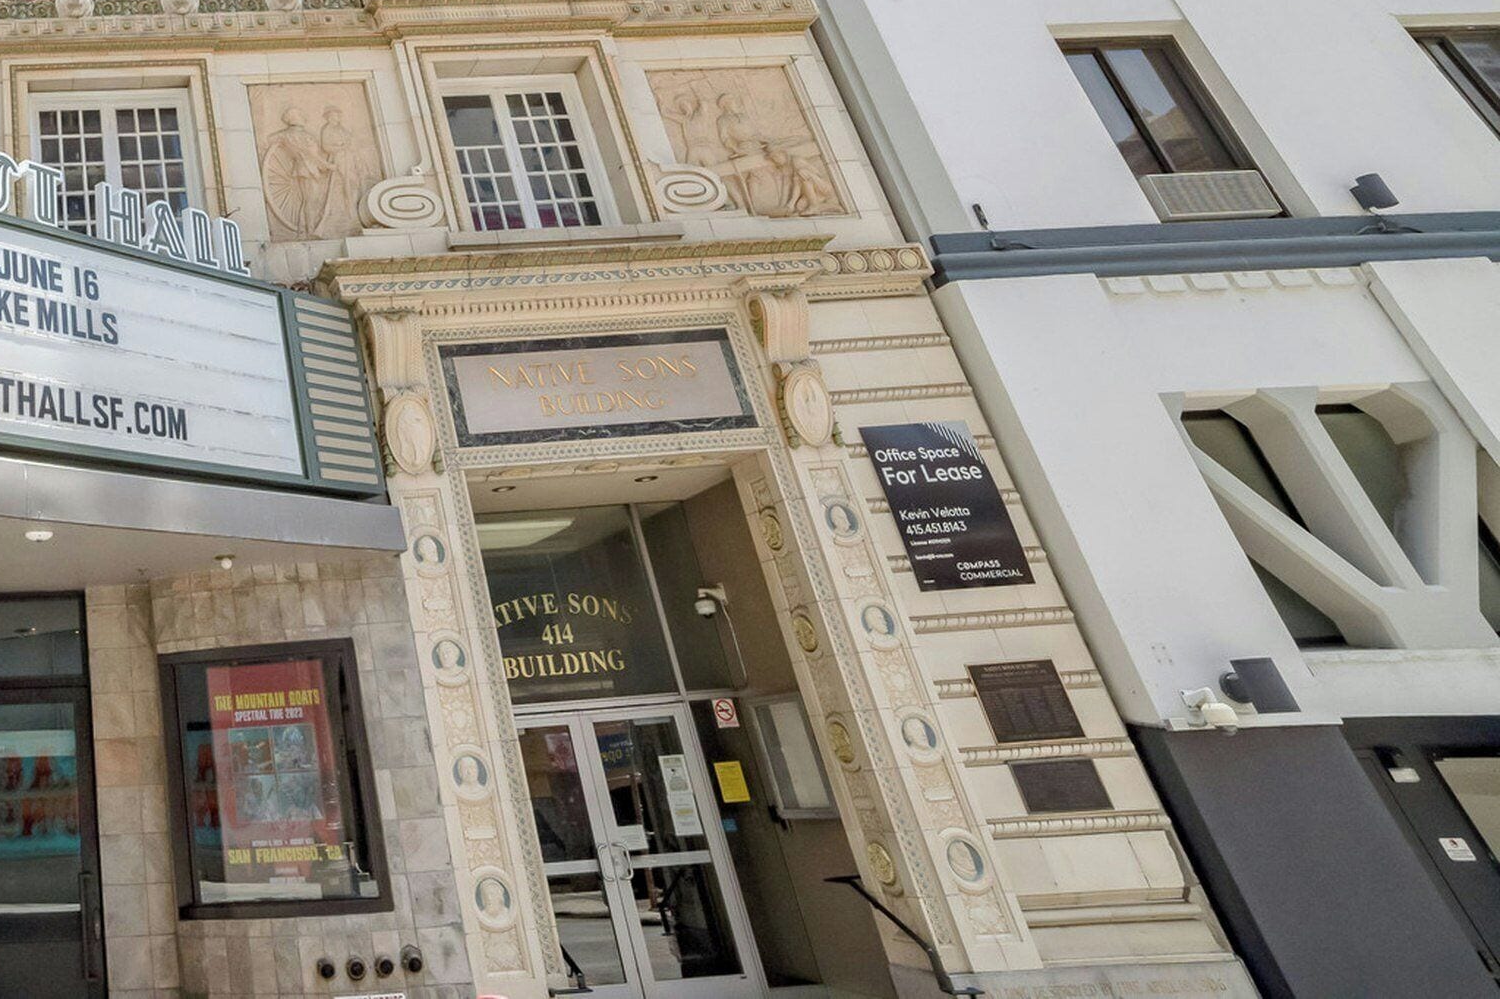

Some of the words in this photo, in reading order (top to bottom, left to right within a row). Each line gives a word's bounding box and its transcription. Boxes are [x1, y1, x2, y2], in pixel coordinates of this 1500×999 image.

[94, 181, 252, 277] HALL
[74, 266, 100, 301] 16
[36, 296, 119, 345] MILLS
[486, 359, 597, 391] NATIVE
[615, 354, 699, 384] SONS
[538, 389, 667, 418] BUILDING
[875, 447, 917, 463] Office
[917, 446, 961, 463] Space
[881, 465, 918, 487] For
[919, 463, 983, 484] Lease
[899, 508, 931, 521] Kevin
[929, 505, 971, 518] Velotta
[905, 520, 968, 536] 415.451.8143
[956, 558, 1002, 571] COMPASS
[959, 567, 1024, 581] COMMERCIAL
[567, 592, 633, 625] SONS
[541, 622, 575, 646] 414
[502, 649, 626, 680] BUILDING
[214, 694, 233, 711] THE
[235, 690, 286, 710] MOUNTAIN
[288, 688, 320, 707] GOATS
[227, 848, 251, 865] SAN
